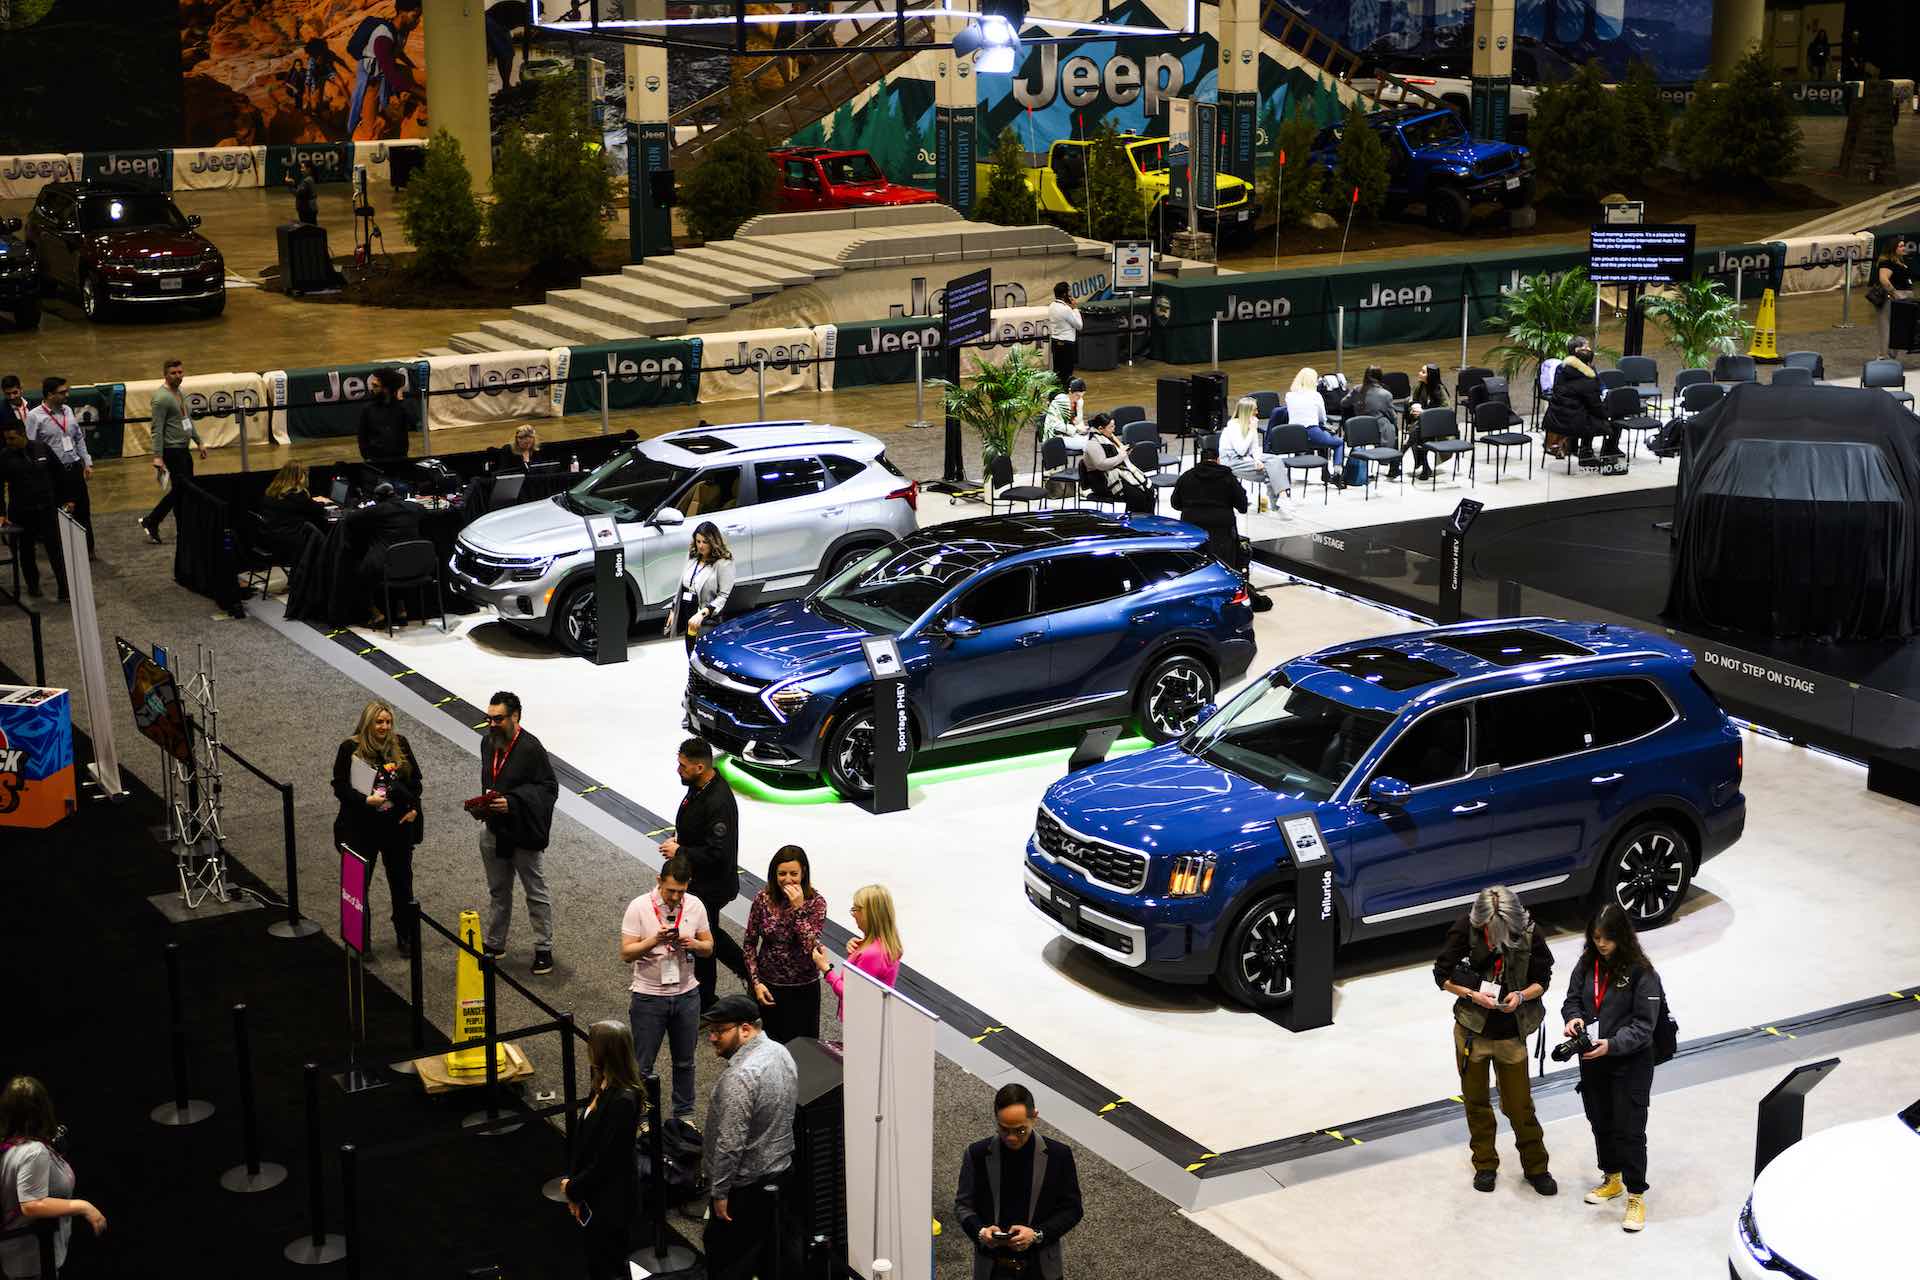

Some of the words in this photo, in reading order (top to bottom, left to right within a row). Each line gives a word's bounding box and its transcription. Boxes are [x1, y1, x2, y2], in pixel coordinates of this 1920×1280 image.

[1012, 43, 1184, 115] Jeep
[1793, 83, 1843, 104] Jeep
[1658, 87, 1697, 103] eep
[3, 158, 69, 183] Jeep
[100, 154, 159, 177] Jeep
[191, 151, 250, 174] Jeep
[1708, 251, 1770, 279] Jeep
[1800, 242, 1862, 270] Jeep
[1072, 273, 1106, 299] OUND
[1360, 283, 1432, 312] Jeep
[1216, 295, 1291, 325] Jeep
[858, 327, 941, 356] Jeep
[593, 352, 684, 389] Jeep
[725, 341, 810, 375] Jeep
[455, 364, 549, 400] Jeep
[187, 388, 260, 424] eep
[1312, 533, 1323, 544] ON
[1323, 535, 1345, 551] STAGE
[615, 553, 623, 577] Seltos
[1452, 557, 1460, 590] Carnival
[1704, 651, 1719, 664] DO
[1721, 657, 1741, 671] NOT
[1742, 663, 1766, 678] STEP
[1767, 670, 1782, 683] ON
[1784, 676, 1815, 694] STAGE
[897, 683, 905, 709] PHEV
[897, 710, 907, 752] Sportage
[1322, 871, 1332, 920] Telluride
